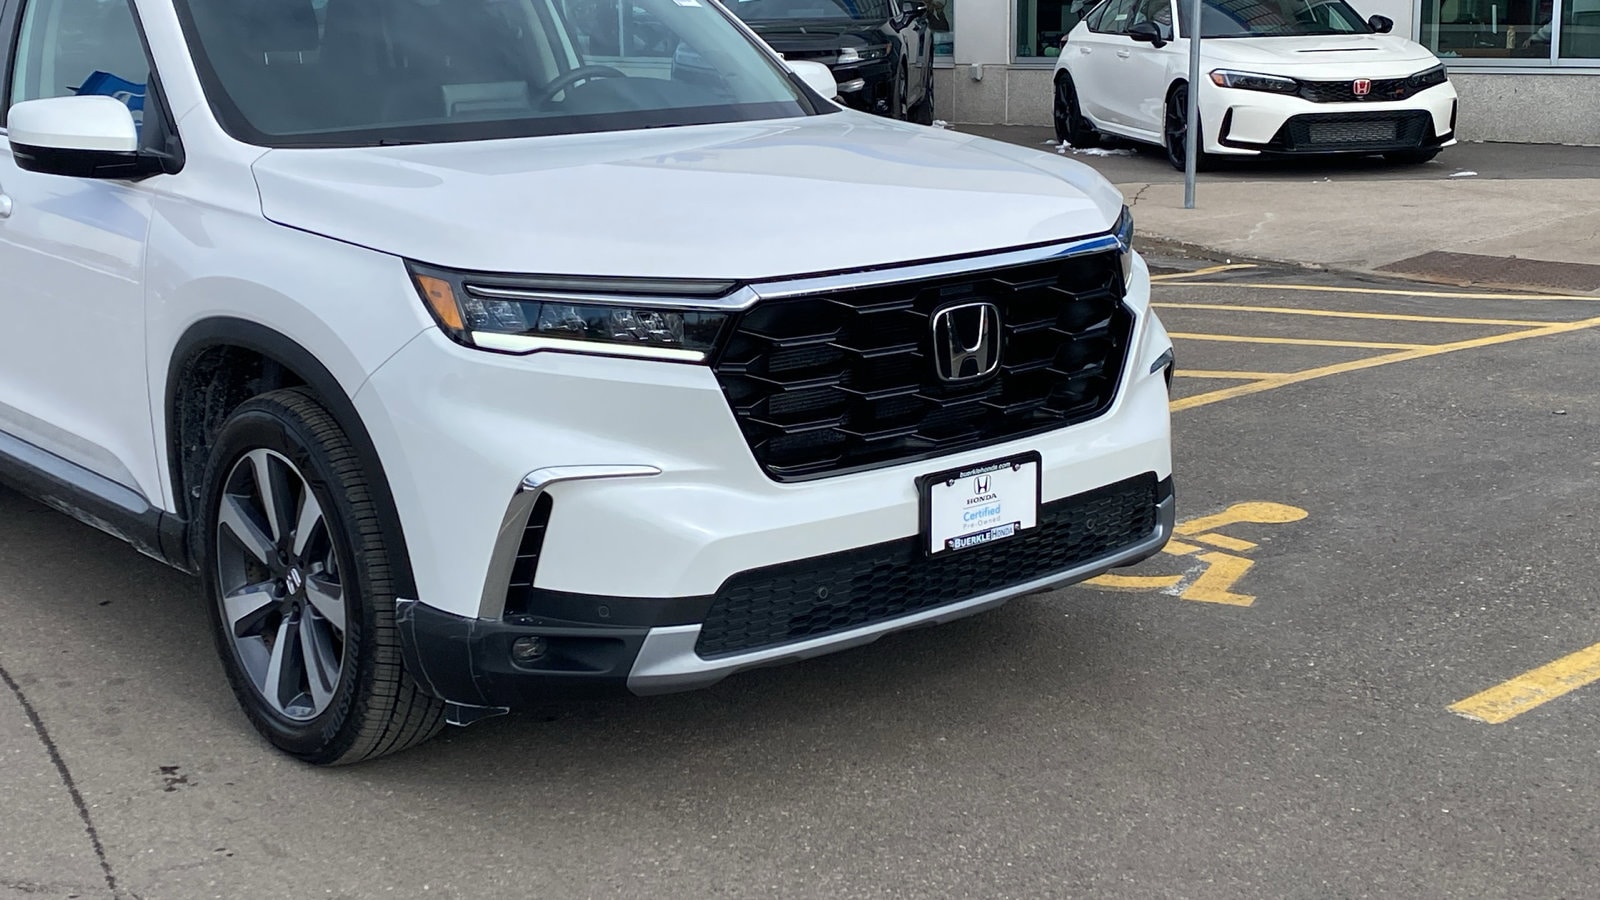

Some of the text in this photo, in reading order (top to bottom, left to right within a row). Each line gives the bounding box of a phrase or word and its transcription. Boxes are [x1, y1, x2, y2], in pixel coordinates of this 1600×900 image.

[966, 493, 997, 505] HONDA
[963, 503, 1001, 522] Certified
[954, 526, 1013, 549] BUERKLE HONDA
